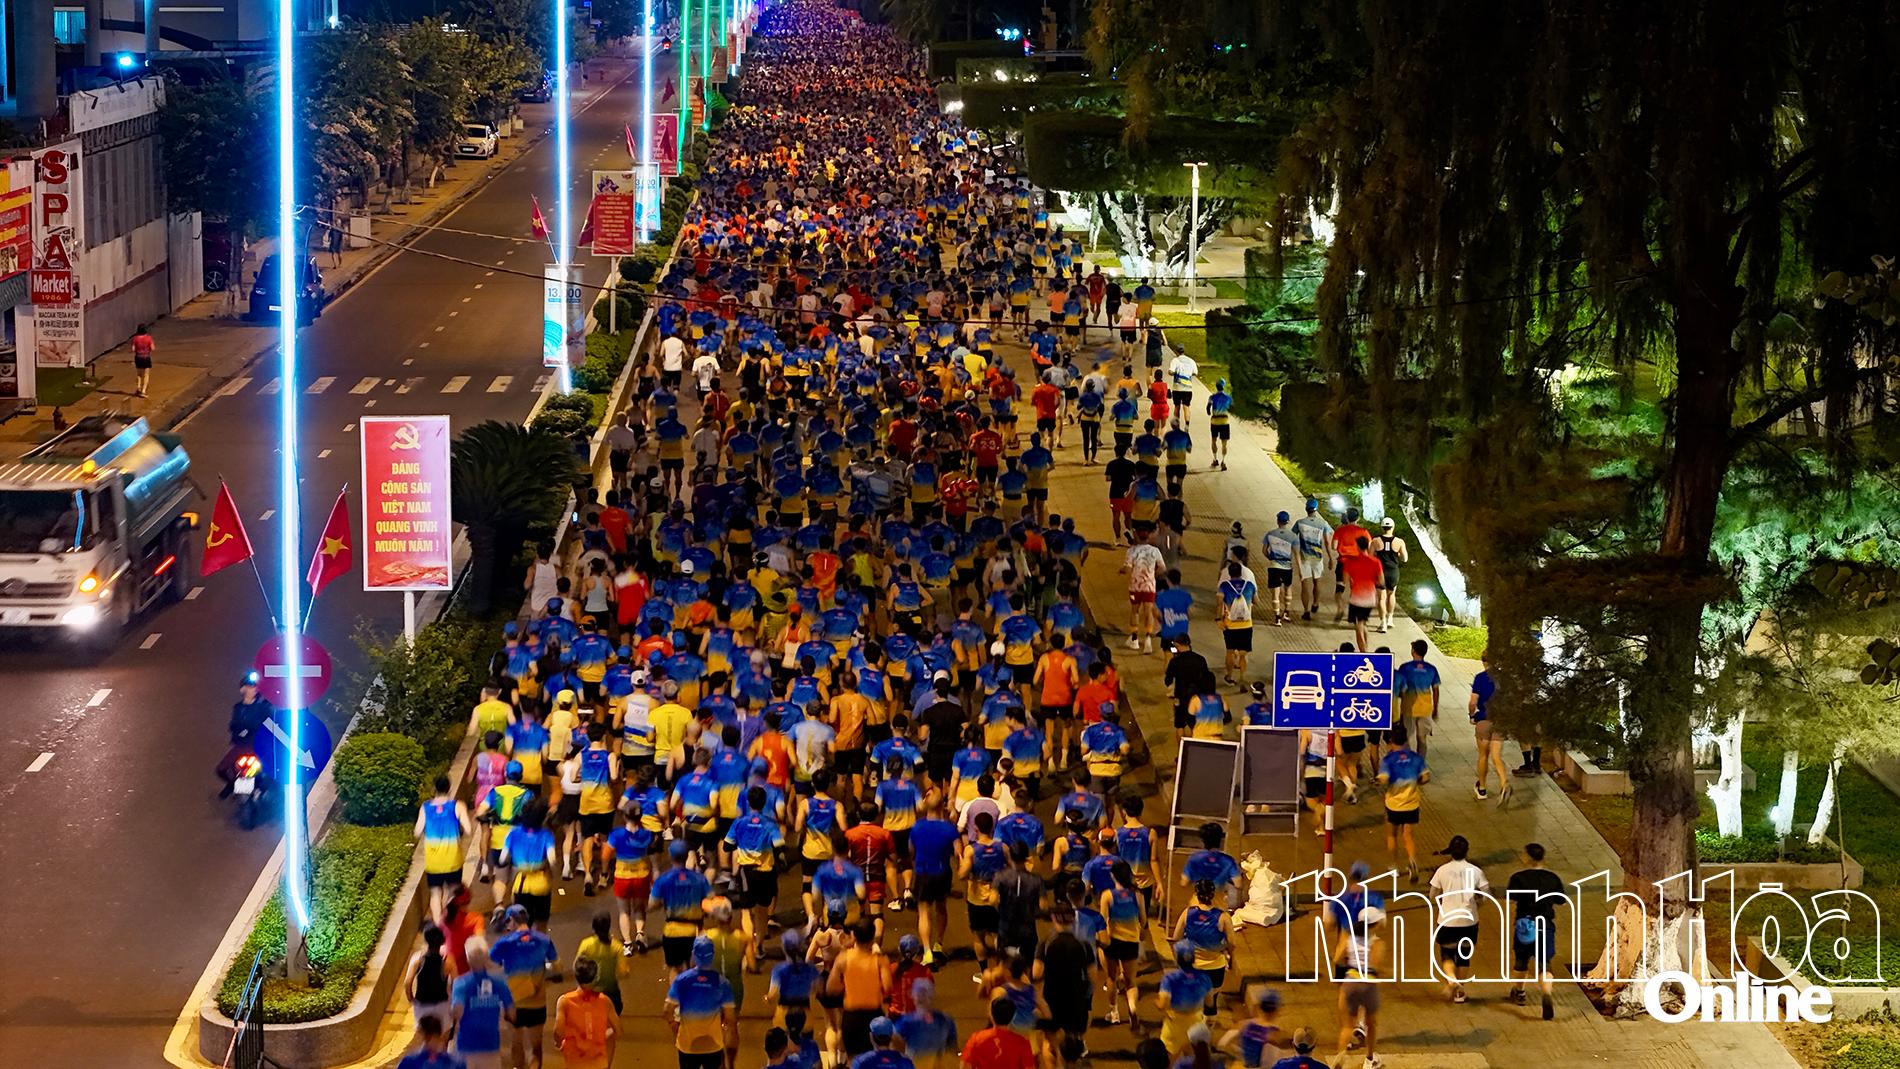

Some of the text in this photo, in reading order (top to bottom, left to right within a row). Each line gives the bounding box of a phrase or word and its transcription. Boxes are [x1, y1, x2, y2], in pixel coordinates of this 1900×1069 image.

[39, 150, 72, 269] SPA
[34, 273, 70, 293] Market
[391, 460, 420, 474] ĐẢNG
[381, 479, 432, 497] CỘNG SẢN
[381, 499, 432, 516] VIỆT NAM
[375, 520, 439, 535] QUANG VINH
[374, 537, 440, 553] MUÔN NĂM !
